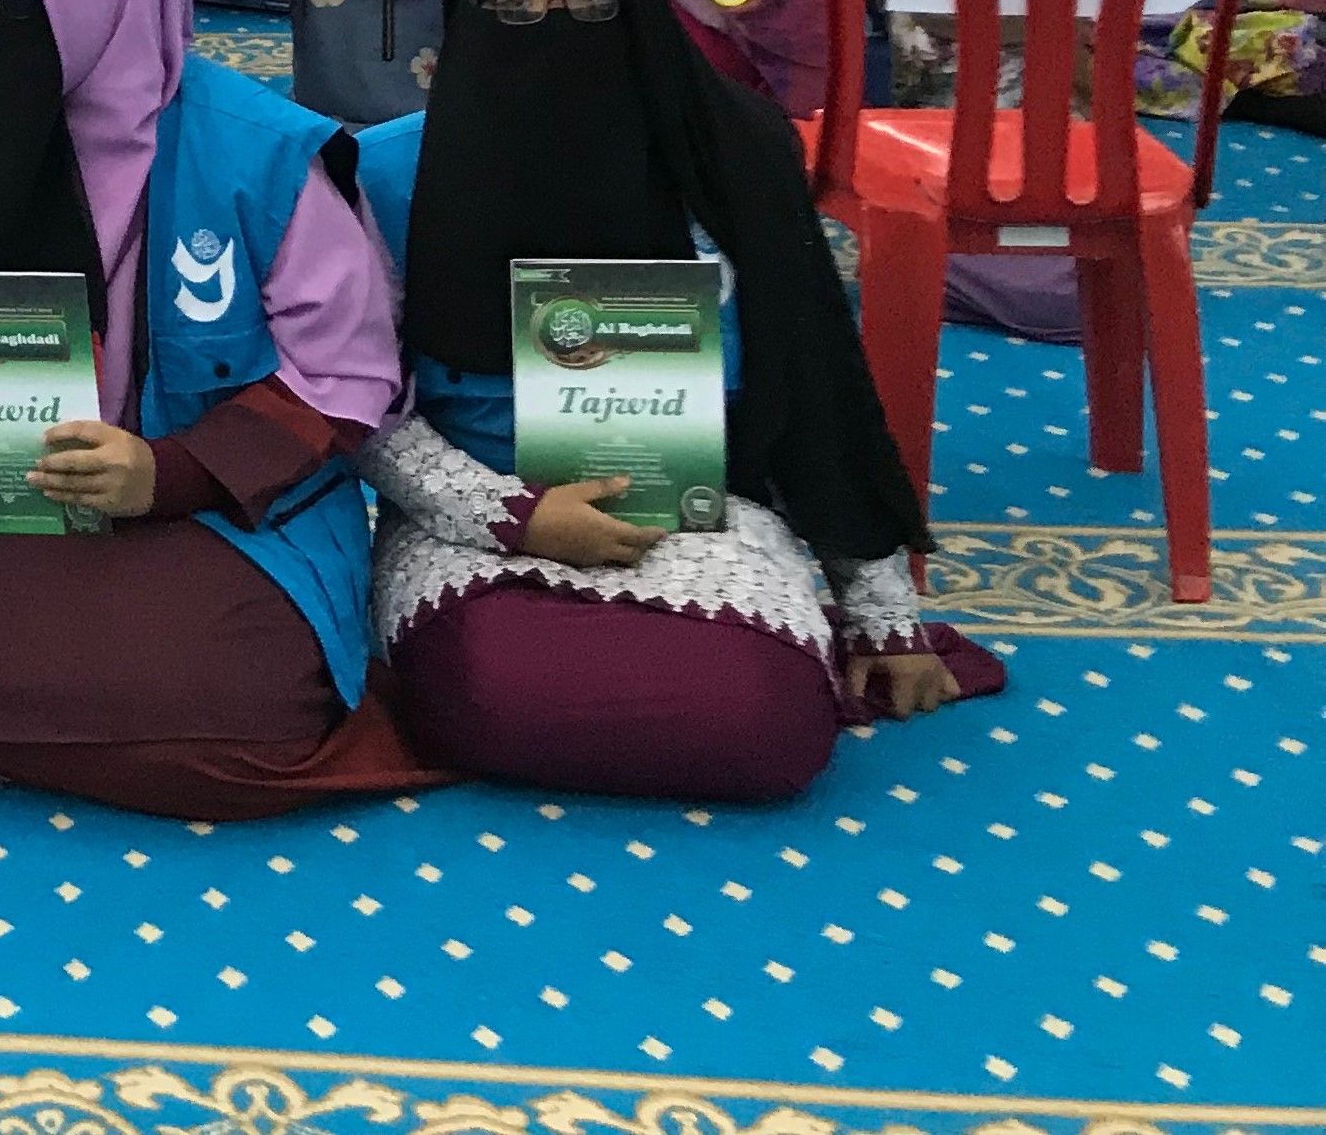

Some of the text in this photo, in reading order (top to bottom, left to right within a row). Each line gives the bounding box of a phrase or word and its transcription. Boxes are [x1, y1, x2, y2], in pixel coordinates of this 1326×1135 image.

[596, 323, 692, 337] Al Baghdadi
[559, 387, 687, 422] Tajwid
